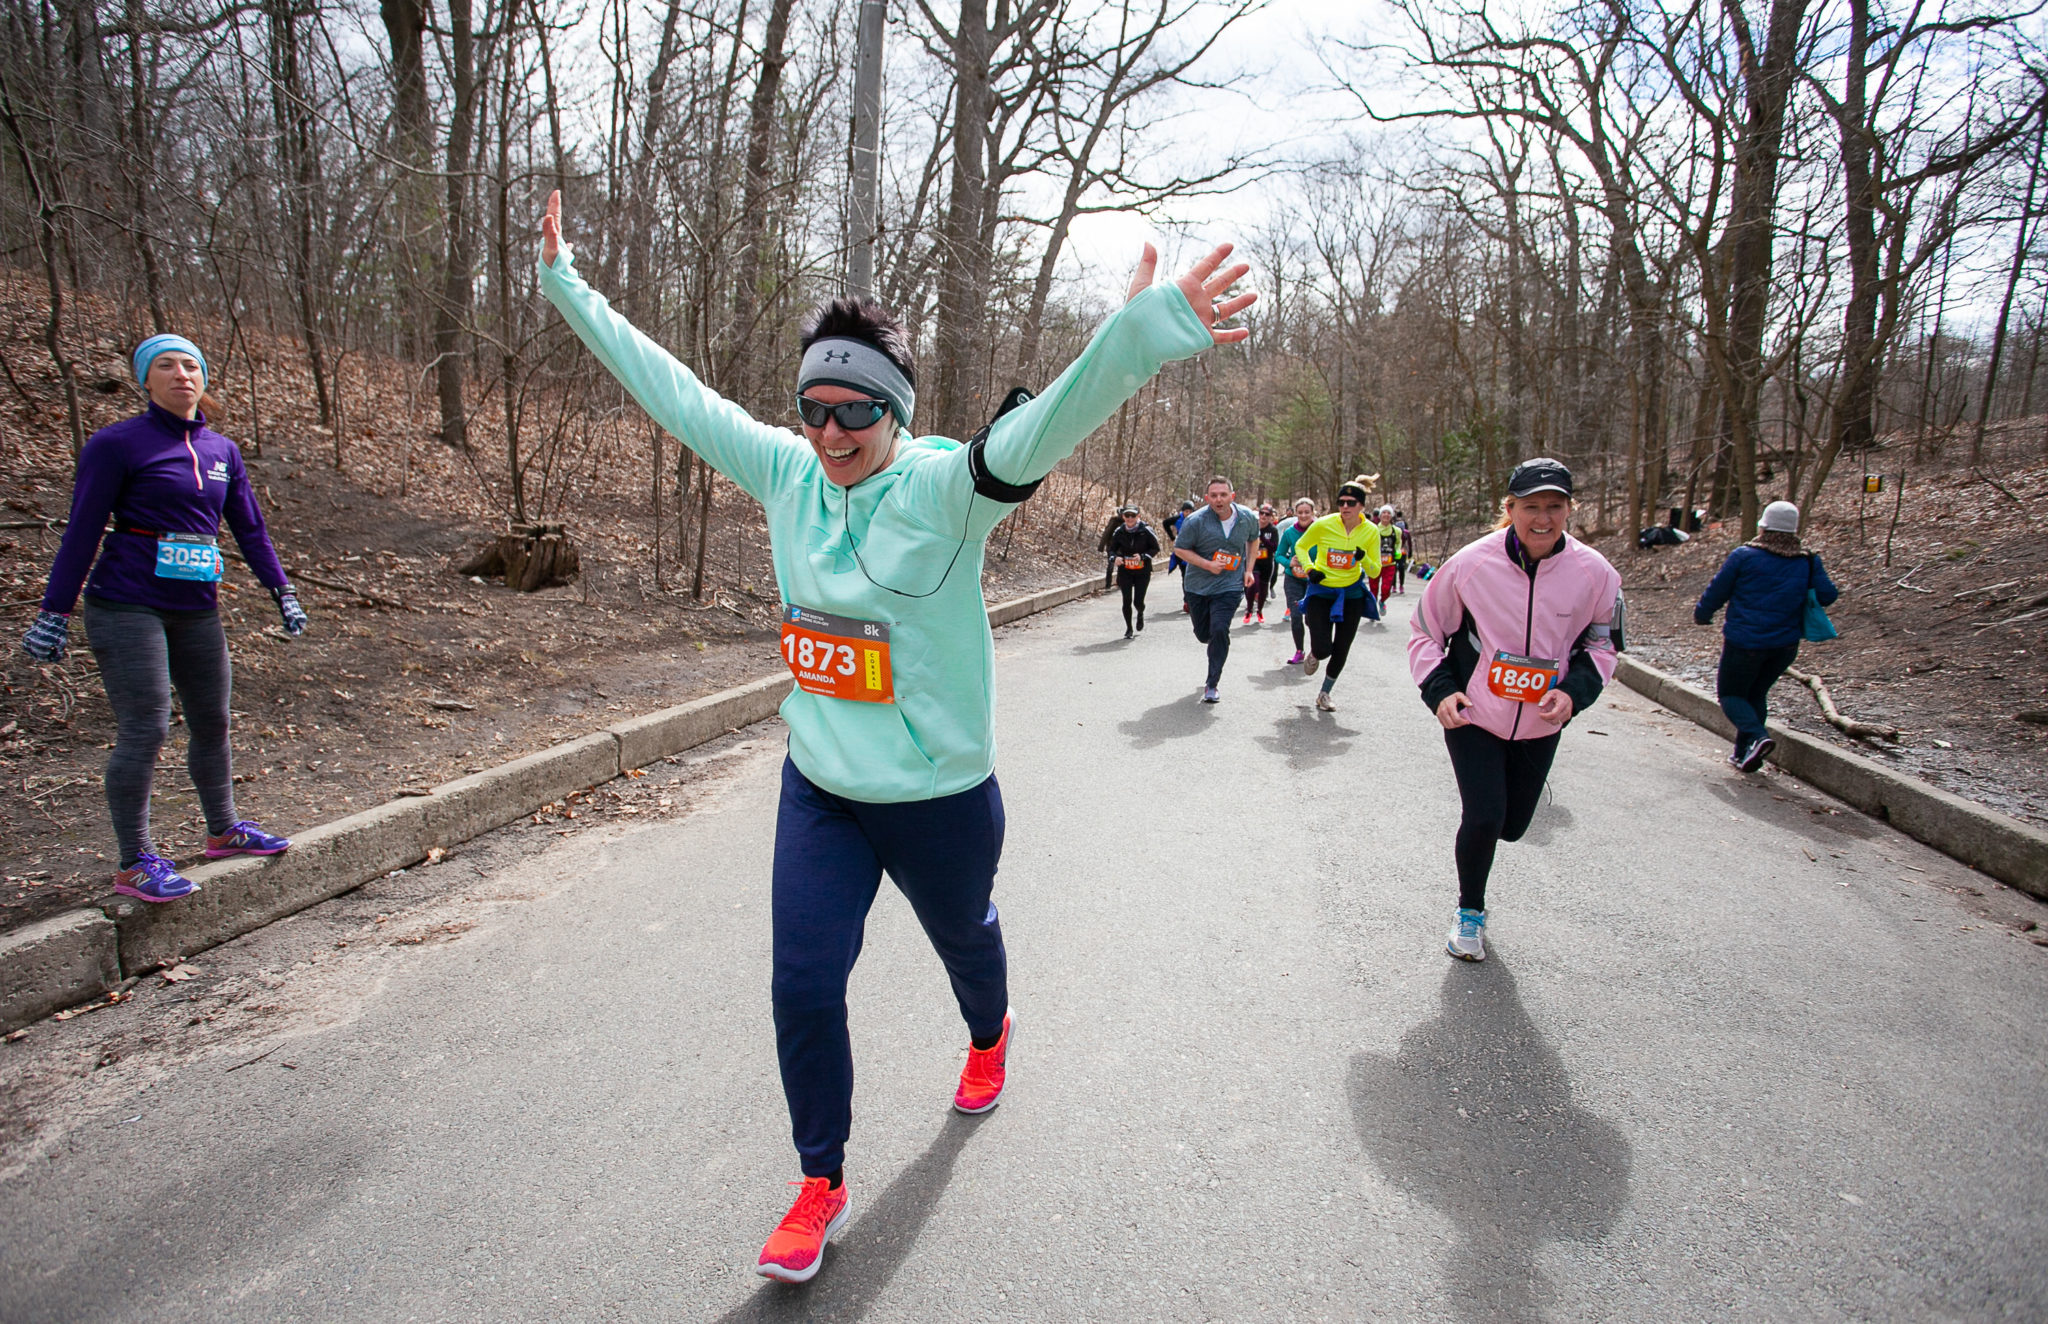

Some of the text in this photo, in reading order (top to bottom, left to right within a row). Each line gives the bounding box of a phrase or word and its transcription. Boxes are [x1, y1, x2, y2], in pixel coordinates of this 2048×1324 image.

[160, 546, 212, 568] 3055
[1330, 555, 1348, 564] 396
[864, 624, 880, 637] 8k
[783, 633, 856, 676] 1873
[798, 670, 836, 685] AMANDA
[1491, 666, 1546, 690] 1860
